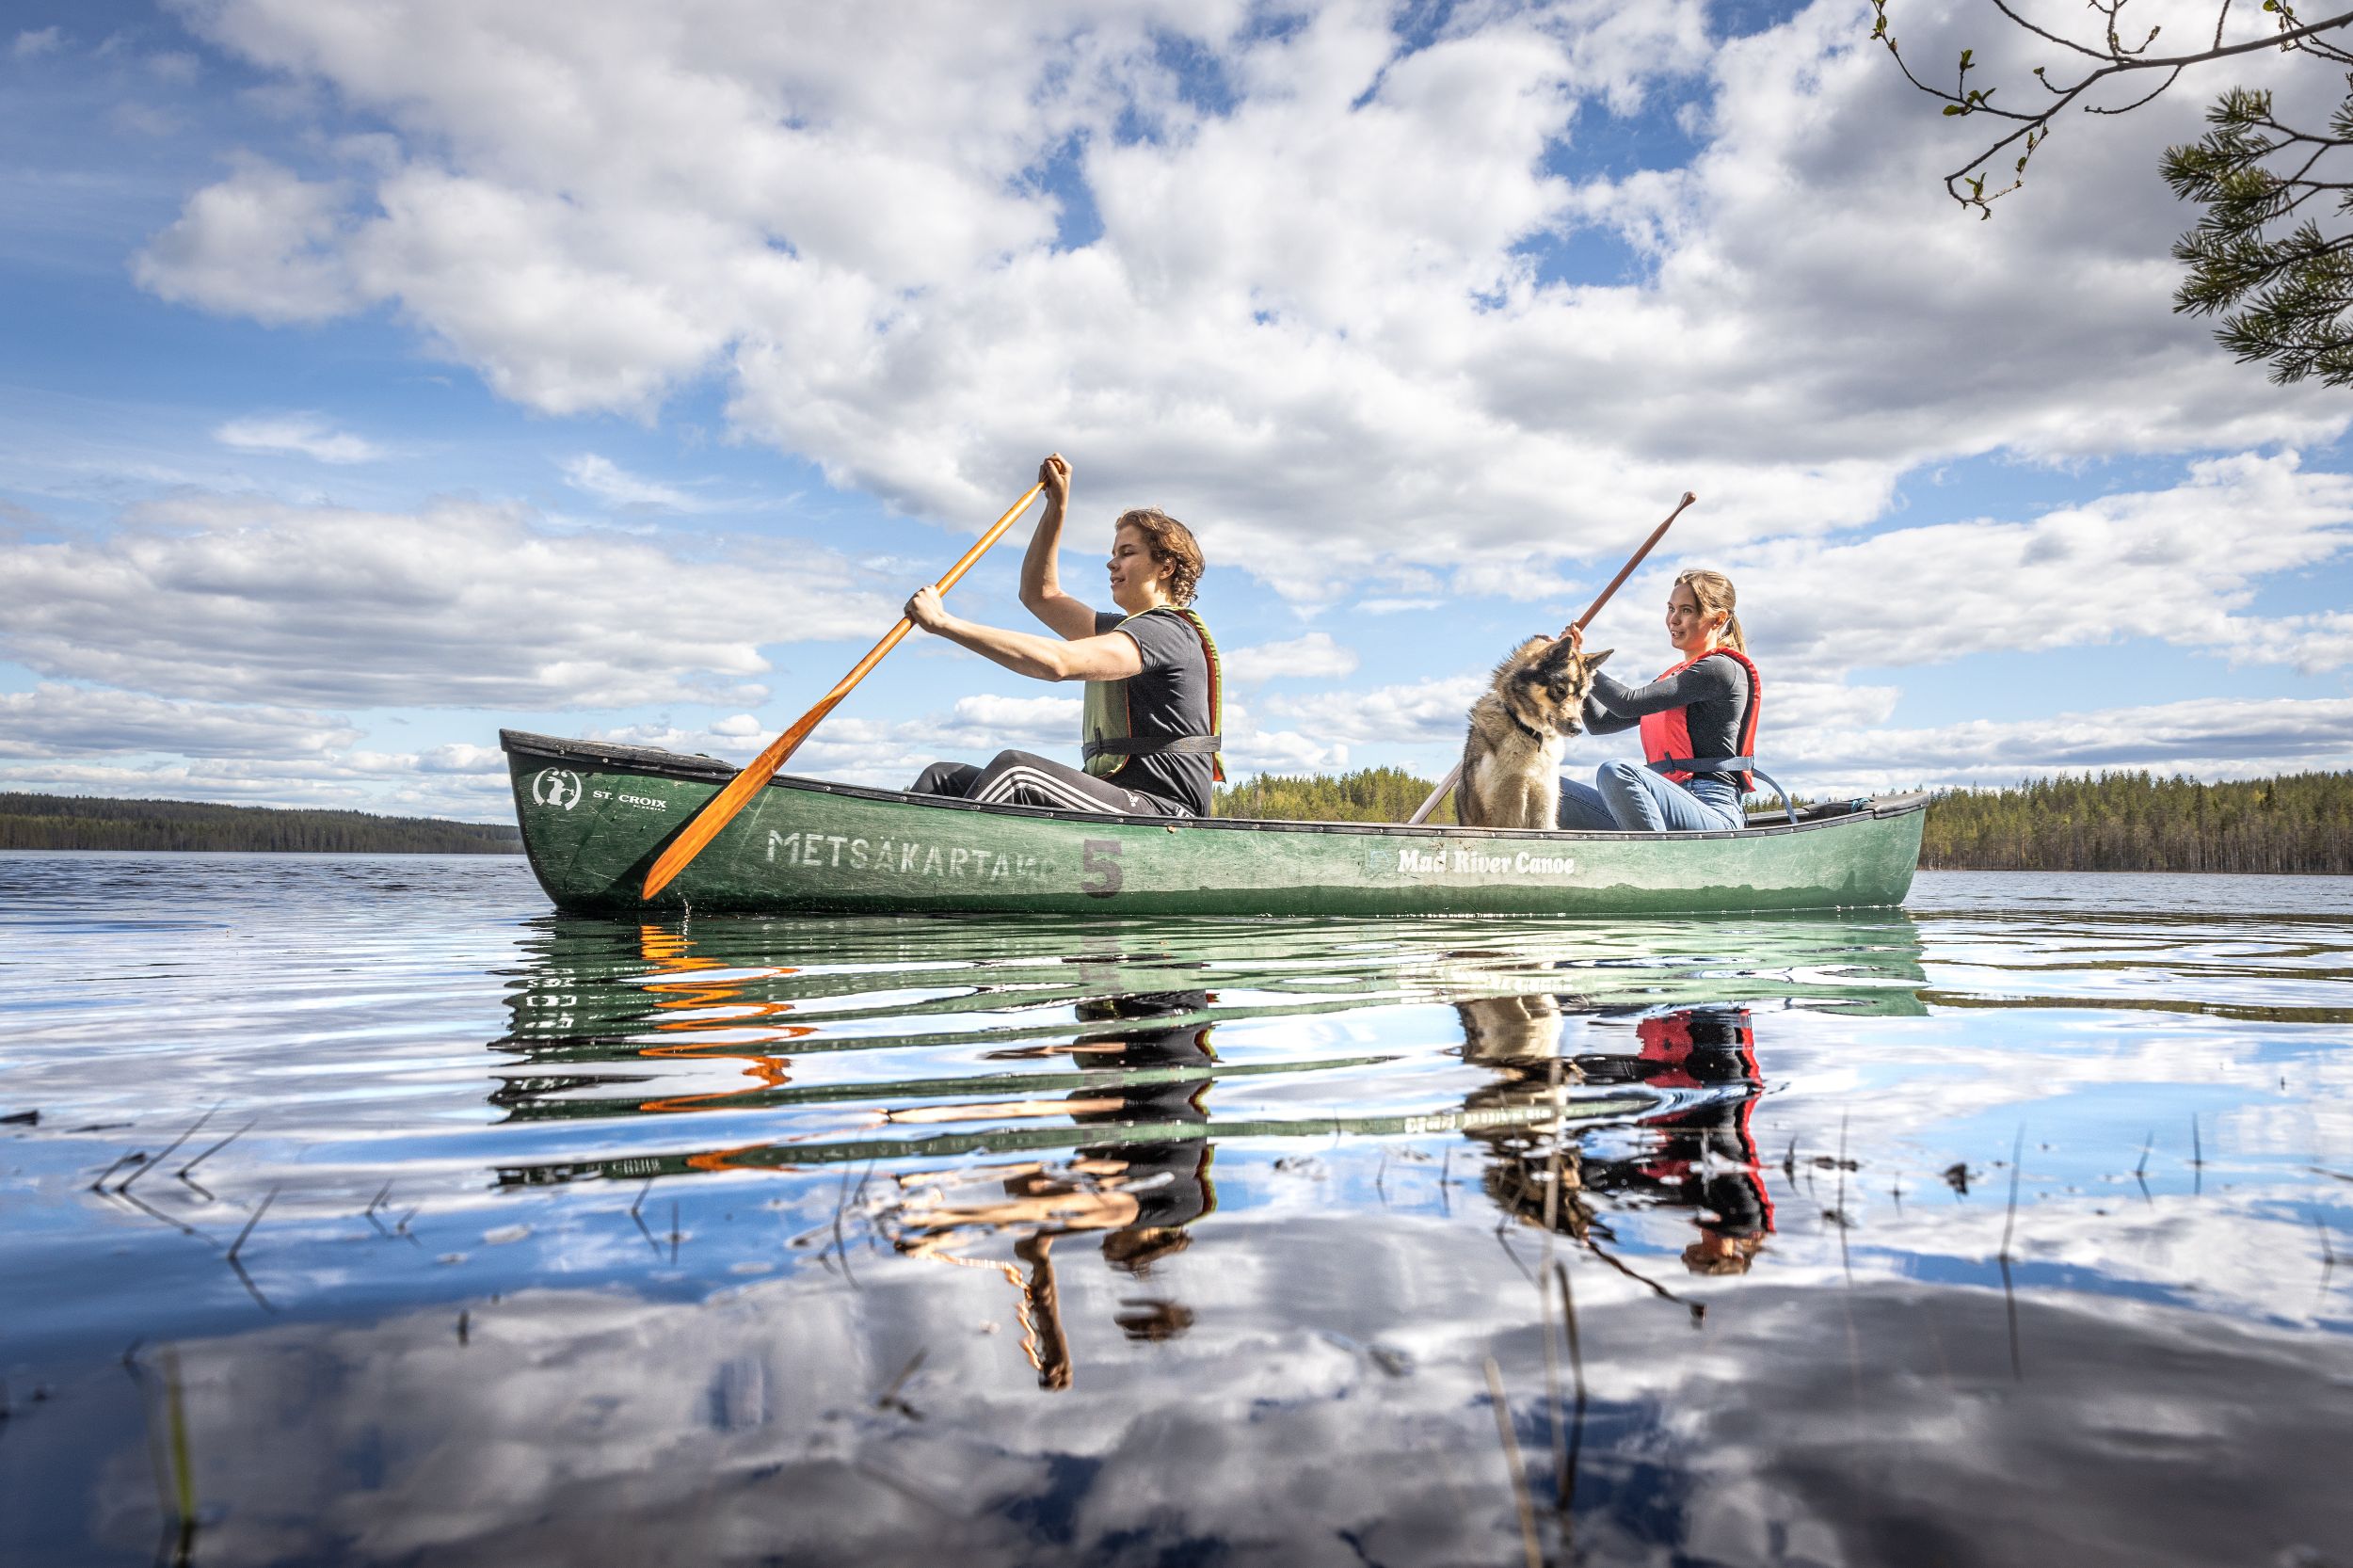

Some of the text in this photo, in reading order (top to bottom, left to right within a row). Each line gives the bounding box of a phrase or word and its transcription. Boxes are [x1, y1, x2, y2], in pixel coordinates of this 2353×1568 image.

[617, 794, 667, 808] CROIX
[1080, 839, 1124, 899] 5
[1397, 849, 1575, 874] Mad River Canoe
